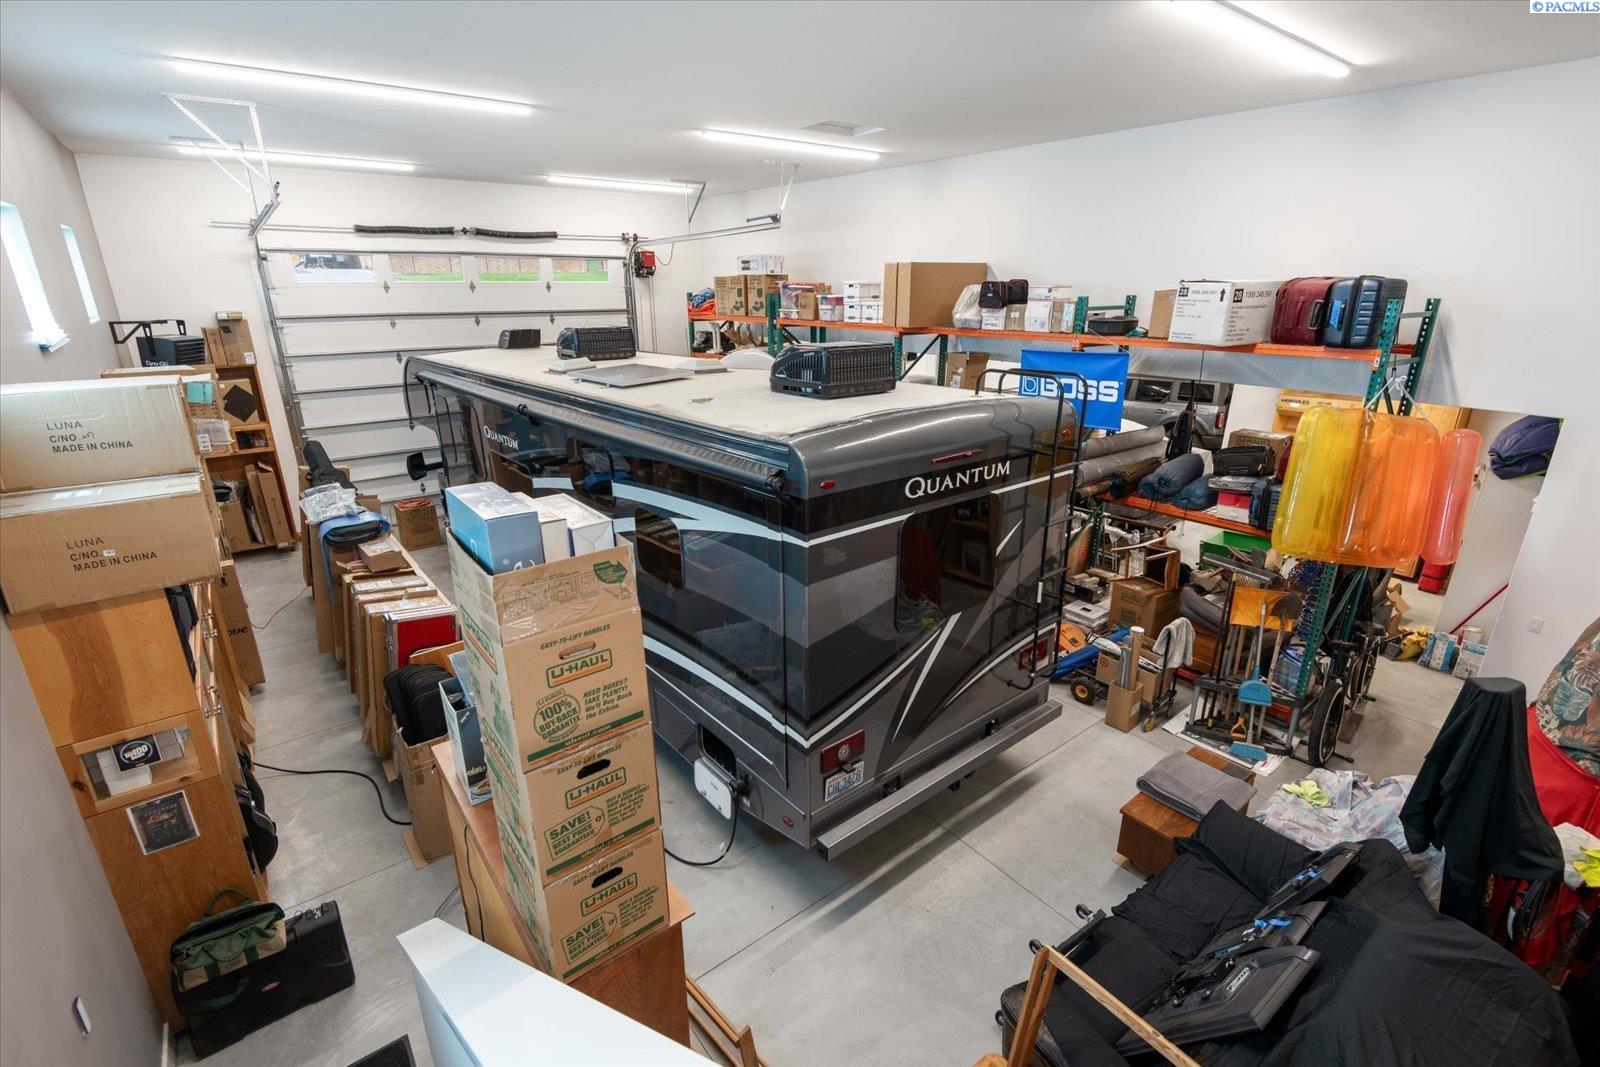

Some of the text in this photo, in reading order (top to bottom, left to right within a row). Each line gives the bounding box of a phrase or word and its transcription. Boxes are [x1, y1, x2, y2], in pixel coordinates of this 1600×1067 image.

[1040, 377, 1119, 402] BOSS
[46, 420, 83, 431] LUNA
[483, 425, 519, 451] QUANTUM
[52, 440, 133, 453] MADE IN CHINA
[904, 460, 1011, 499] QUANTUM
[66, 536, 105, 550] LUNA
[73, 559, 108, 572] MADE
[109, 557, 120, 566] IN
[123, 551, 158, 563] CHINA
[583, 623, 611, 637] HANDLES
[550, 654, 608, 679] U-HAUL
[583, 687, 601, 698] NEED
[539, 698, 572, 721] 100%
[569, 773, 623, 800] U-HAUL
[549, 811, 591, 840] SAVE!
[552, 823, 593, 850] BEST PRICE
[584, 878, 634, 908] U-HAUL
[566, 916, 605, 946] SAVE!
